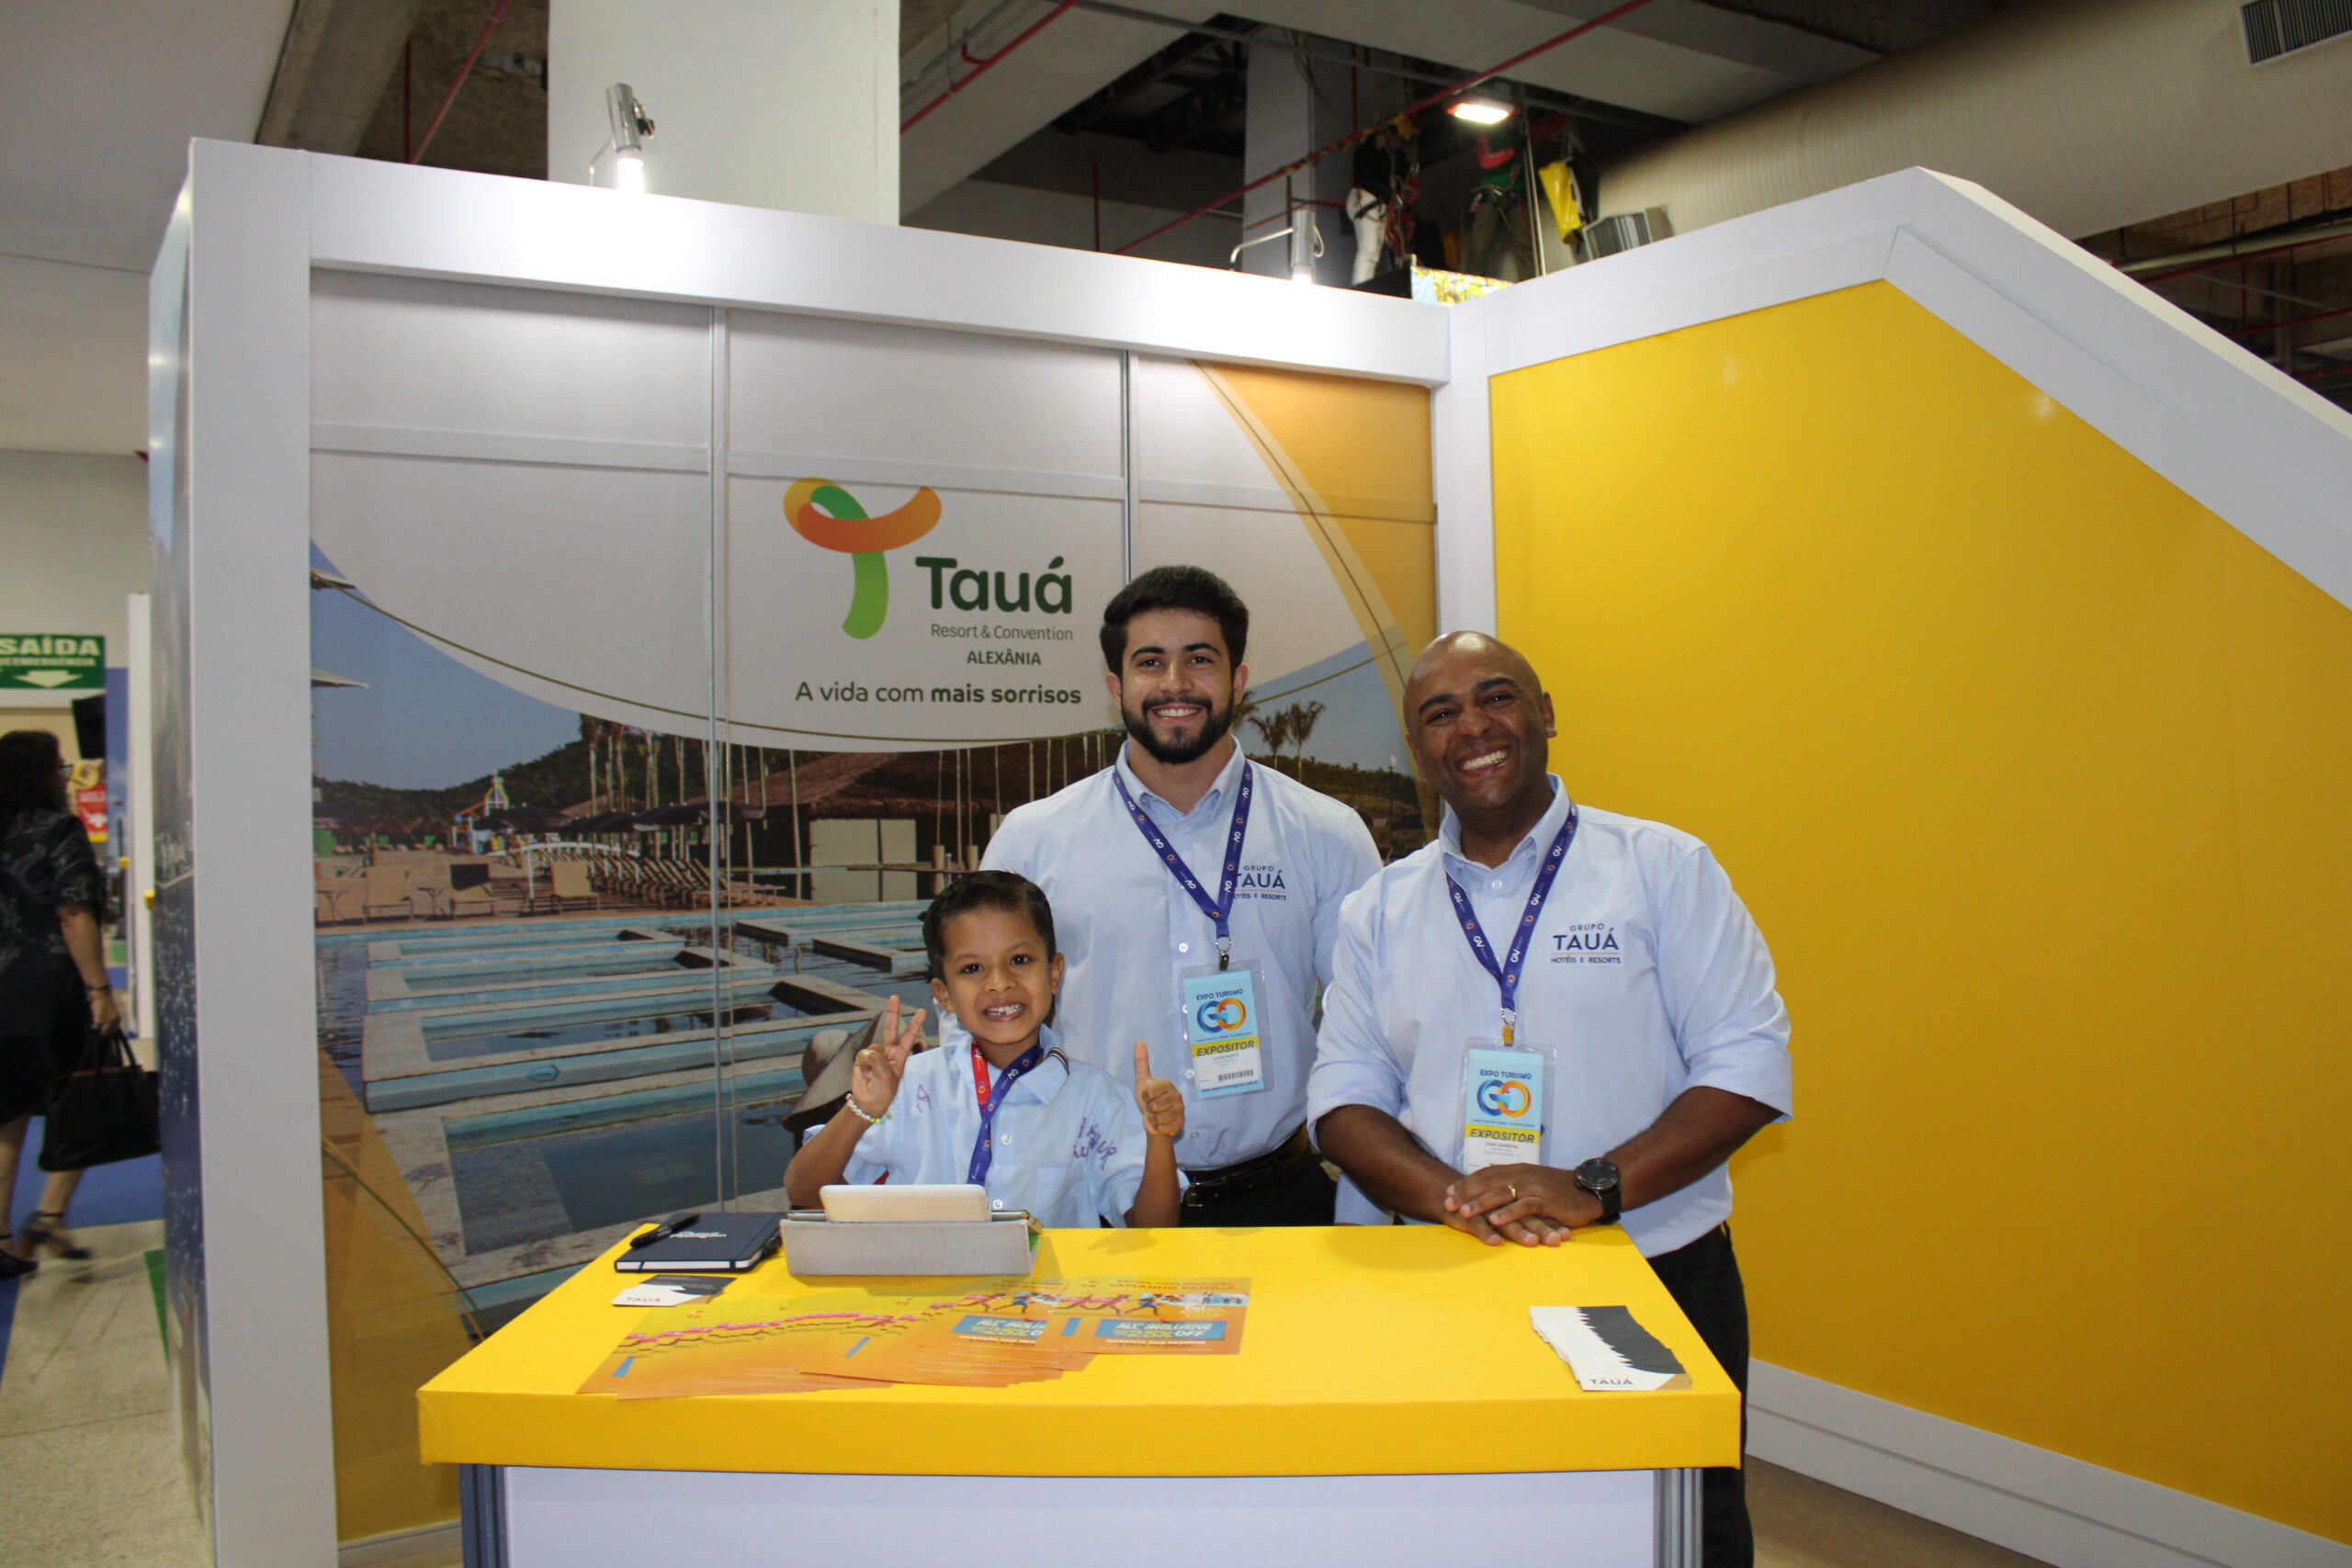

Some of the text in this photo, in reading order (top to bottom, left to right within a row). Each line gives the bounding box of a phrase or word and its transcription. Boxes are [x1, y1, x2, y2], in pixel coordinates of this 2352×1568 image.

[914, 555, 1072, 615] Tauá
[931, 624, 1073, 641] Resort & Convention
[0, 634, 100, 656] SAÍDA
[967, 648, 1041, 666] ALEXÂNIA
[795, 682, 1081, 704] A vida com mais sorrisos
[1570, 923, 1605, 931] GRUPO
[1553, 928, 1619, 951] TAUÁ
[1551, 955, 1577, 964] HOTÉIS
[1196, 1040, 1255, 1056] EXPOSITOR
[1470, 1128, 1535, 1144] EXPOSITOR
